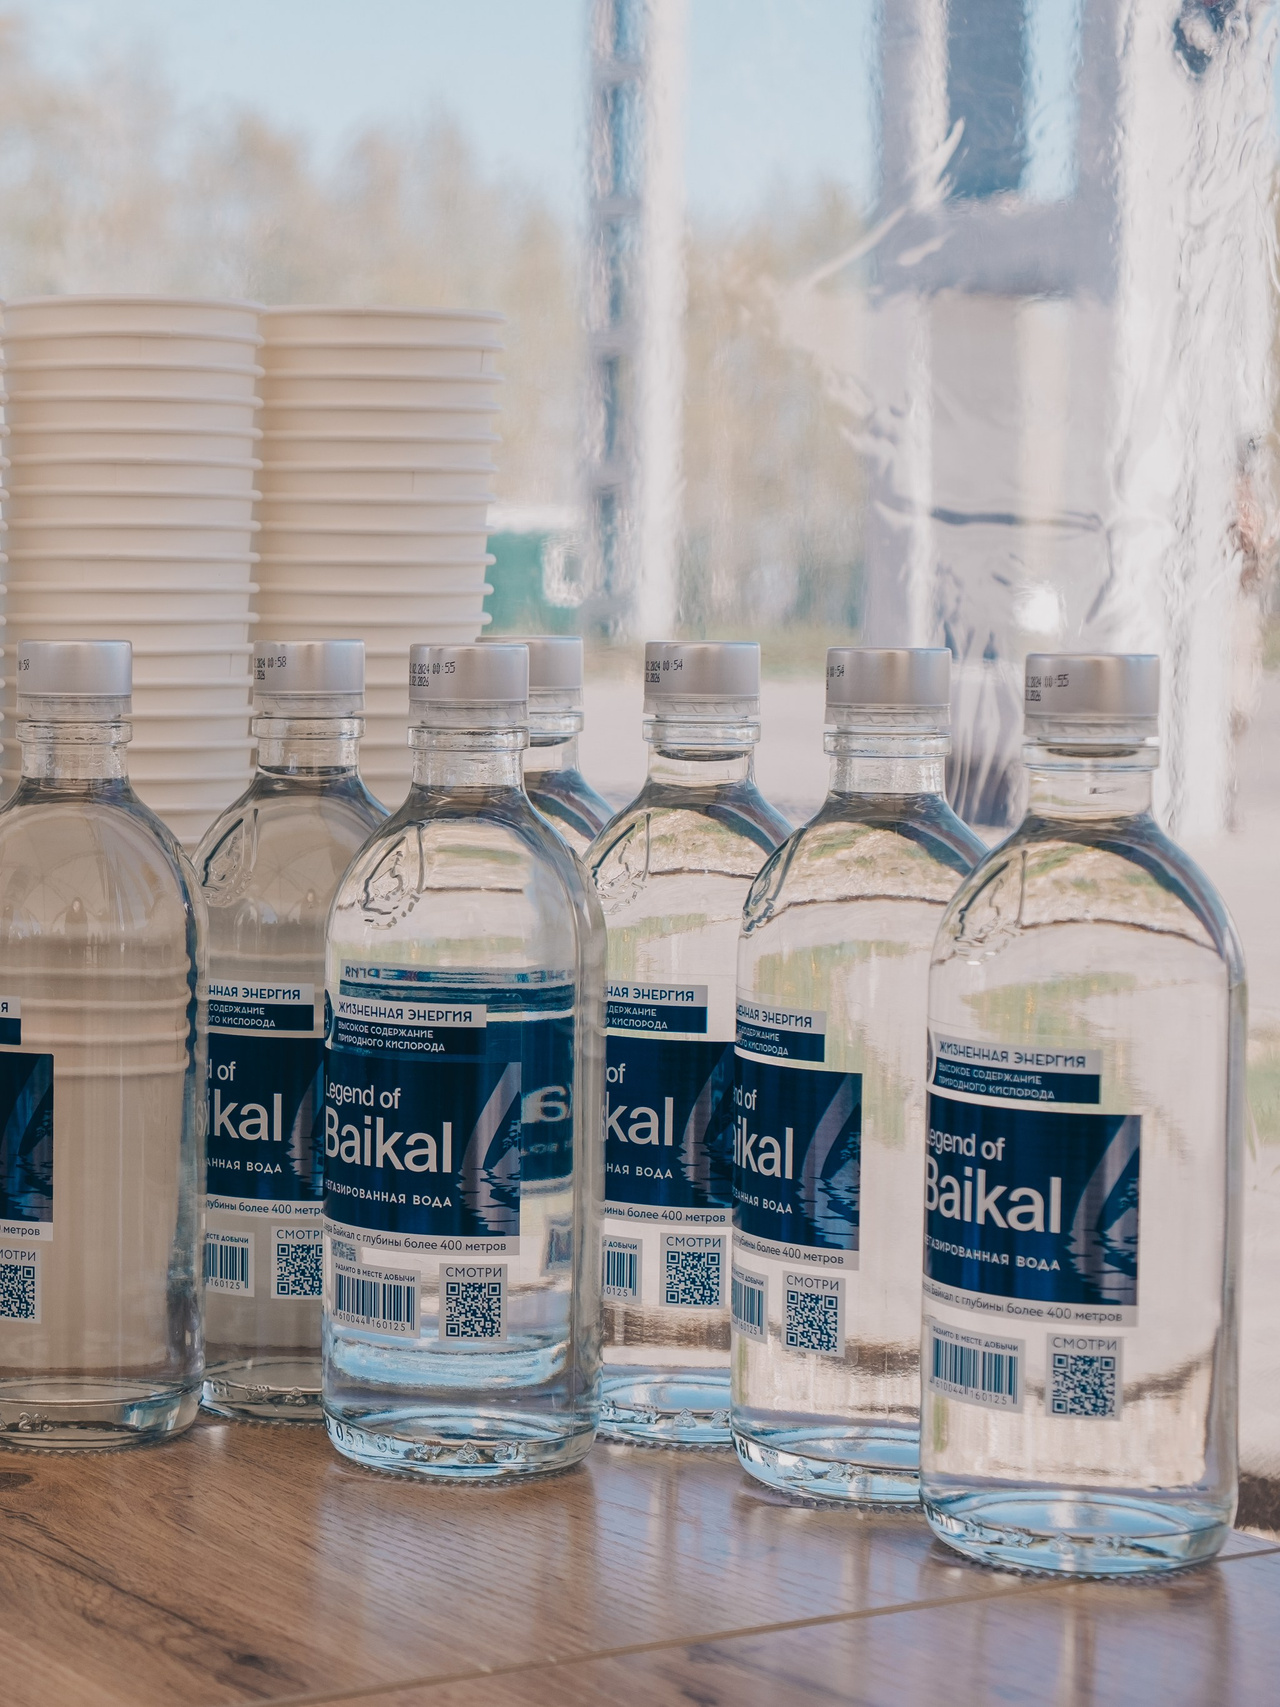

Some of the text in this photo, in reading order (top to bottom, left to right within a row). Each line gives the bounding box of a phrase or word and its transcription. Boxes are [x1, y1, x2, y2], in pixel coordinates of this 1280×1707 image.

[242, 988, 301, 1000] ЭНЕРГИЯ
[632, 988, 694, 1002] ЭНЕРГИЯ
[209, 1003, 265, 1015] СОДЕРЖАНИЕ
[338, 1001, 472, 1022] ЖИЗНЕННАЯ ЭНЕРГИЯ
[222, 1017, 276, 1028] КИСЛОРОДА
[612, 1018, 668, 1030] КИСЛОРОДА
[761, 1011, 812, 1028] ЭНЕРГИЯ
[338, 1020, 433, 1039] ВЫСОКОЕ СОДЕРЖАНИЕ
[337, 1033, 445, 1052] ПРИРОДНОГО КИСЛОРОДА
[748, 1041, 789, 1056] КИСЛОРОДА
[940, 1041, 1086, 1068] ЖИЗНЕННАЯ ЭНЕРГИЯ
[217, 1061, 237, 1081] of
[606, 1063, 626, 1083] of
[938, 1062, 1042, 1085] ВЫСОКОЕ СОДЕРЖАНИЕ
[325, 1075, 401, 1109] Legend of
[938, 1075, 1055, 1100] ПРИРОДНОГО КИСЛОРОДА
[744, 1089, 757, 1110] of
[325, 1105, 452, 1173] Baikal
[980, 1137, 1006, 1161] of
[246, 1162, 283, 1174] ВОДА
[635, 1166, 673, 1179] ВОДА
[413, 1195, 452, 1208] ВОДА
[925, 1153, 1062, 1234] Baikal
[239, 1202, 269, 1213] более
[271, 1204, 292, 1214] 400
[762, 1198, 793, 1214] ВОДА
[627, 1207, 659, 1219] более
[661, 1210, 683, 1220] 400
[685, 1214, 726, 1224] метров
[4, 1227, 40, 1237] метров
[221, 1234, 249, 1244] ДОБЫЧИ
[333, 1224, 506, 1253] Байкал с глубины более 400 метров
[608, 1241, 637, 1250] ДОБЫЧИ
[666, 1236, 721, 1248] СМОТРИ
[757, 1241, 781, 1255] более
[782, 1248, 801, 1259] 400
[804, 1253, 844, 1265] метров
[445, 1267, 502, 1277] СМОТРИ
[1015, 1255, 1061, 1272] ВОДА
[335, 1262, 356, 1274] РАЗЛИТО
[362, 1269, 383, 1279] МЕСТЕ
[384, 1272, 415, 1283] ДОБЫЧИ
[210, 1278, 240, 1290] 160125
[786, 1275, 839, 1291] СМОТРИ
[931, 1283, 954, 1302] Байкал
[955, 1295, 960, 1303] с
[961, 1297, 1004, 1312] глубины
[1006, 1303, 1044, 1317] более
[1046, 1308, 1072, 1319] 400
[1075, 1312, 1123, 1323] метров
[339, 1312, 365, 1325] 610044
[371, 1320, 406, 1332] 160125
[933, 1325, 955, 1340] РАЗЛИТО
[961, 1335, 982, 1346] МЕСТЕ
[984, 1338, 1019, 1351] ДОБЫЧИ
[1052, 1337, 1117, 1351] СМОТРИ
[935, 1380, 964, 1395] 610044
[970, 1389, 1008, 1405] 160125
